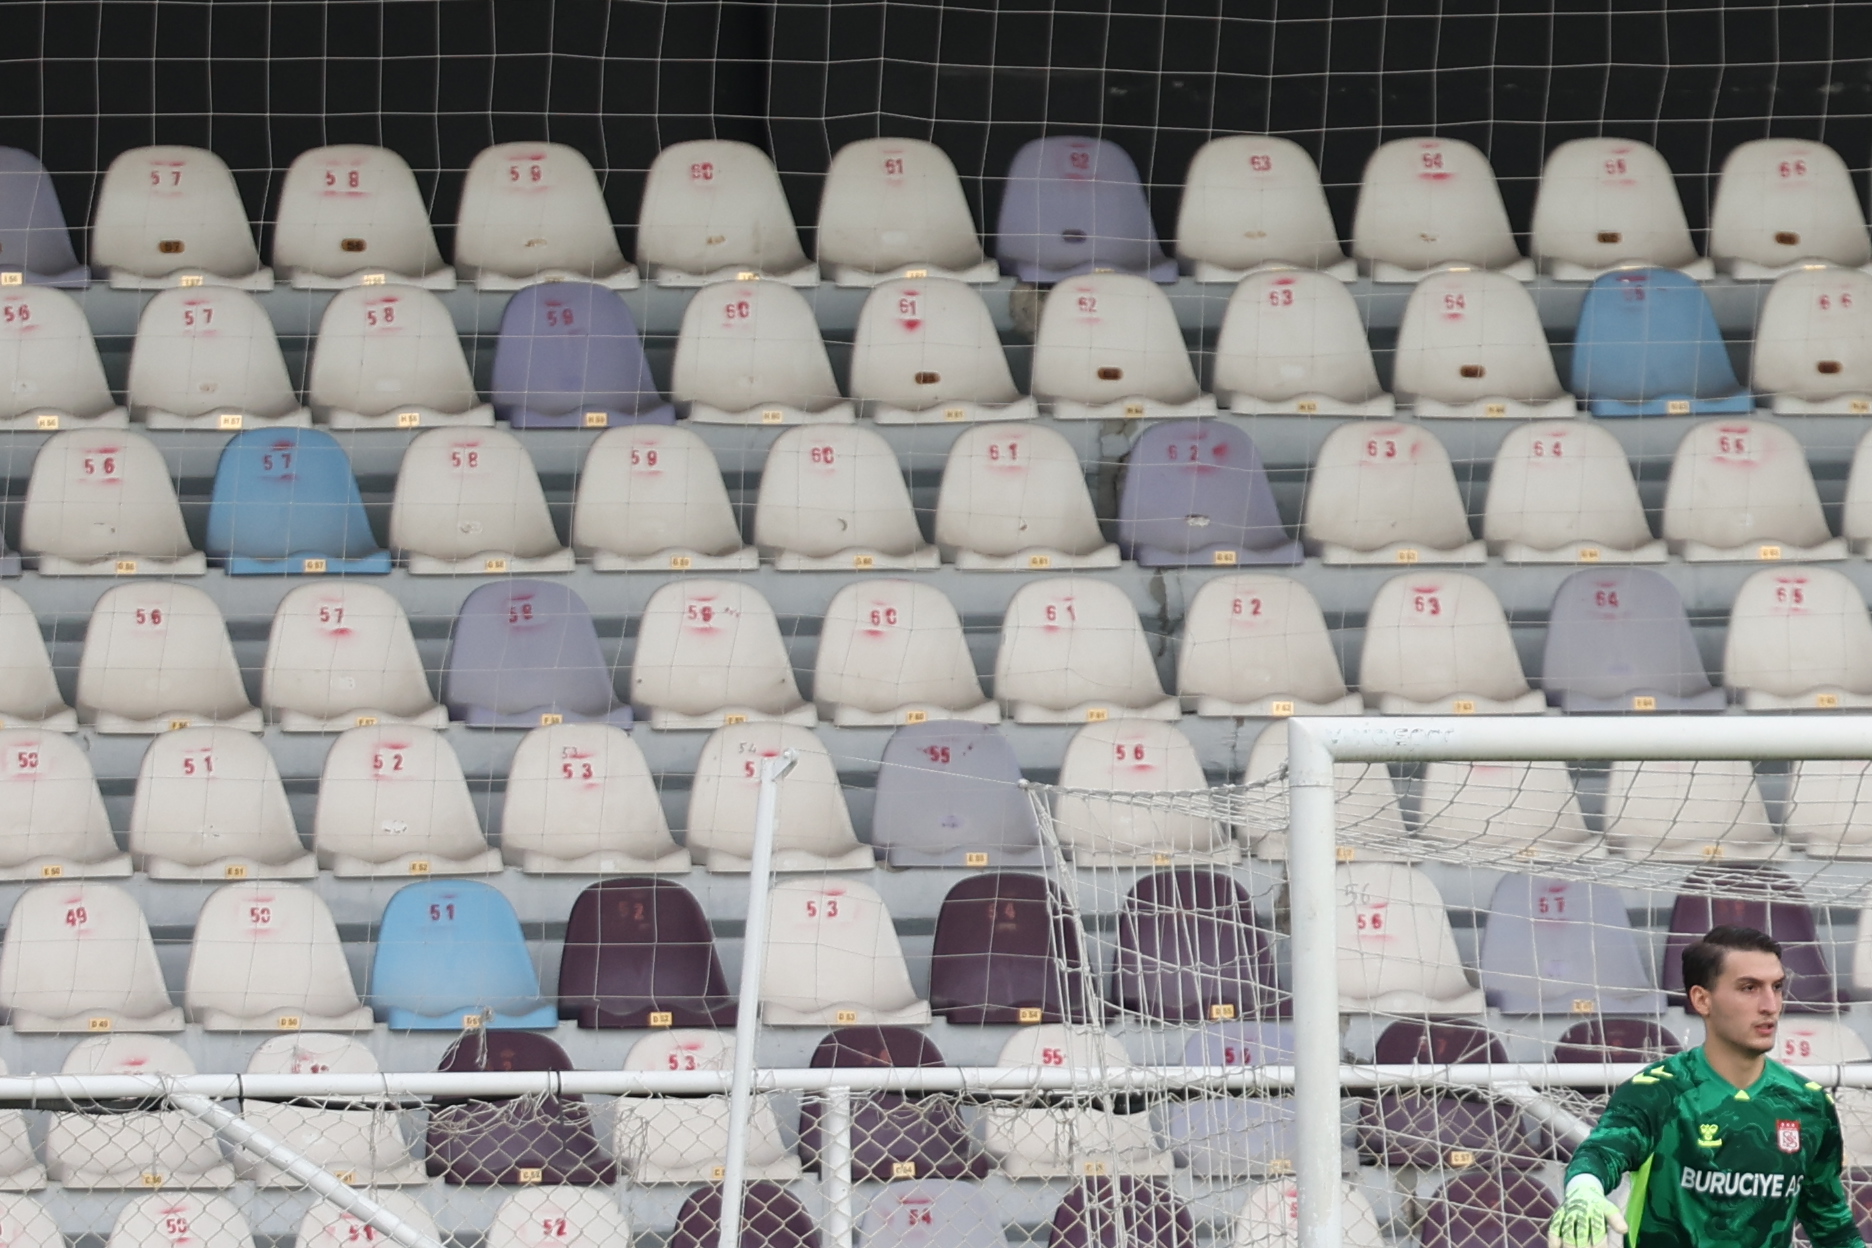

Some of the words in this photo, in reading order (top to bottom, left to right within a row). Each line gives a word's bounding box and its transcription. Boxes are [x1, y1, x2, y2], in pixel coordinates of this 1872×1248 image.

[884, 159, 904, 175] 61
[1250, 155, 1272, 173] 63
[151, 170, 182, 187] 57
[326, 171, 360, 188] 58
[1077, 297, 1098, 315] 62
[1269, 289, 1293, 306] 63
[4, 305, 30, 322] 56
[725, 300, 749, 319] 60
[898, 298, 916, 316] 61
[184, 309, 213, 326] 57
[366, 306, 395, 326] 58
[811, 447, 834, 464] 60
[988, 443, 1018, 461] 61
[1366, 440, 1397, 459] 63
[84, 458, 115, 474] 56
[263, 453, 292, 470] 57
[452, 451, 479, 469] 58
[631, 451, 658, 466] 59
[1045, 605, 1075, 621] 61
[1233, 599, 1262, 616] 62
[1415, 596, 1441, 616] 63
[136, 609, 162, 625] 56
[319, 607, 344, 623] 57
[870, 608, 896, 625] 60
[18, 752, 38, 768] 50
[929, 746, 951, 765] 55
[1116, 745, 1144, 760] 56
[183, 757, 212, 775] 51
[372, 753, 402, 771] 52
[562, 763, 593, 780] 53
[66, 908, 87, 926] 49
[250, 907, 270, 924] 50
[429, 904, 455, 921] 51
[806, 901, 838, 918] 53
[1358, 914, 1383, 929] 56
[1784, 1038, 1810, 1057] 59
[668, 1054, 696, 1070] 53
[1042, 1048, 1063, 1066] 55
[166, 1219, 188, 1234] 50
[543, 1219, 567, 1237] 52
